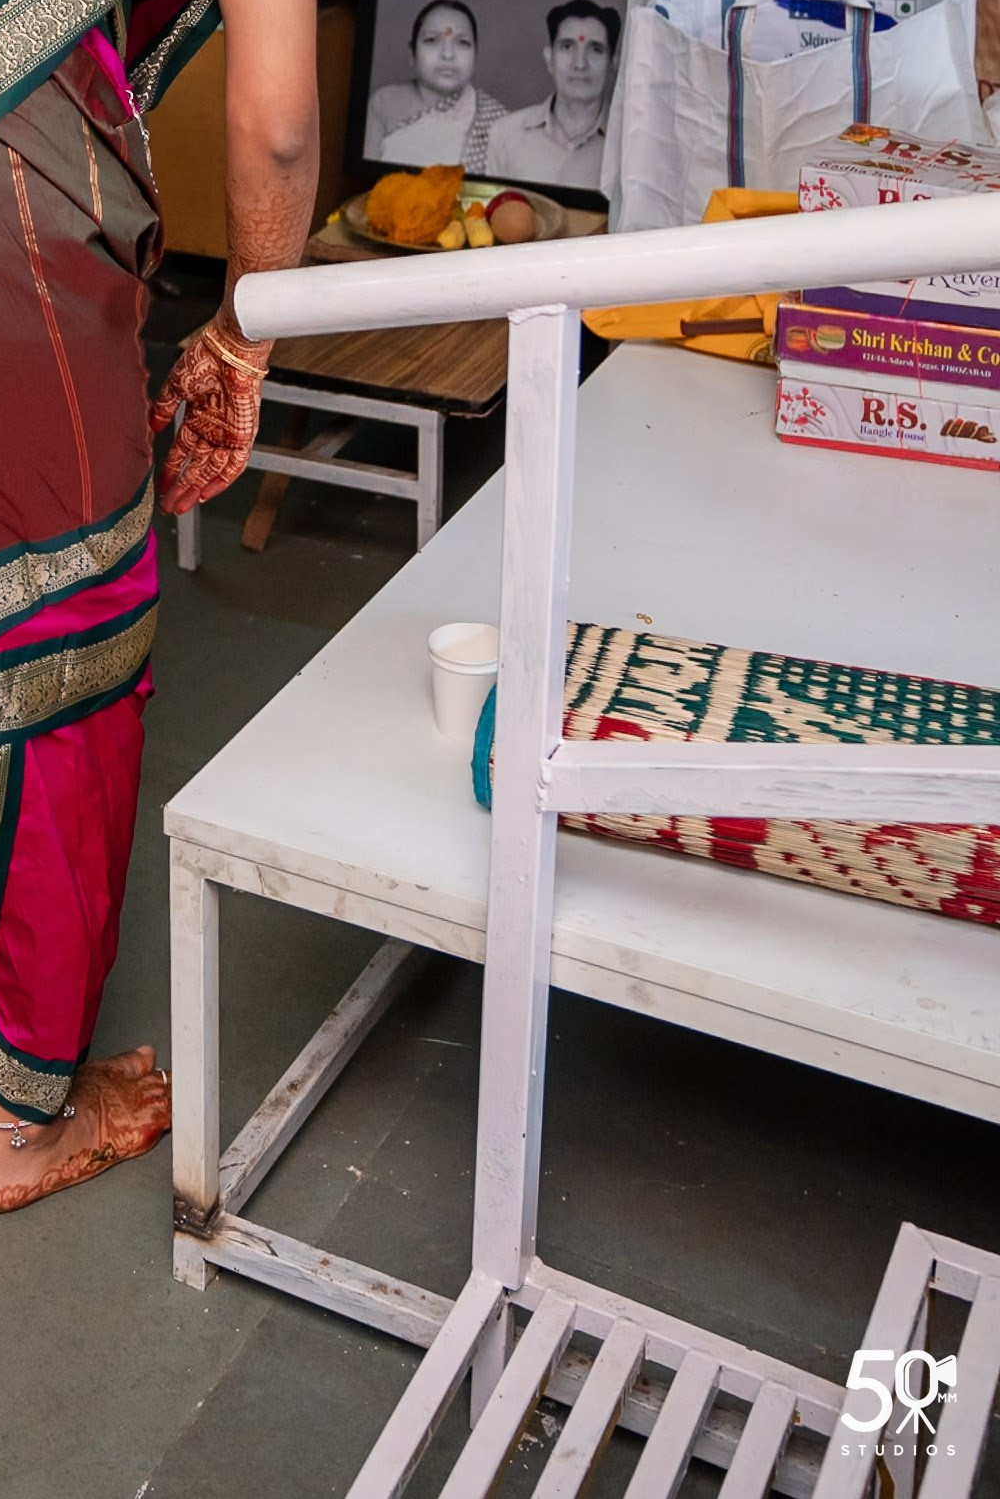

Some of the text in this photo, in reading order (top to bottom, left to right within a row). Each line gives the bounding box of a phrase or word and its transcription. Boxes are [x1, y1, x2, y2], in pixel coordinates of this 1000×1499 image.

[819, 160, 867, 175] Radha
[878, 140, 983, 170] R.S.
[852, 328, 885, 350] Shri
[890, 333, 952, 360] Krishan
[957, 343, 971, 361] &
[889, 357, 914, 367] Adarsh
[941, 364, 992, 377] FIROZABAD
[861, 397, 927, 430] R.S.
[860, 425, 926, 442] Bangle House
